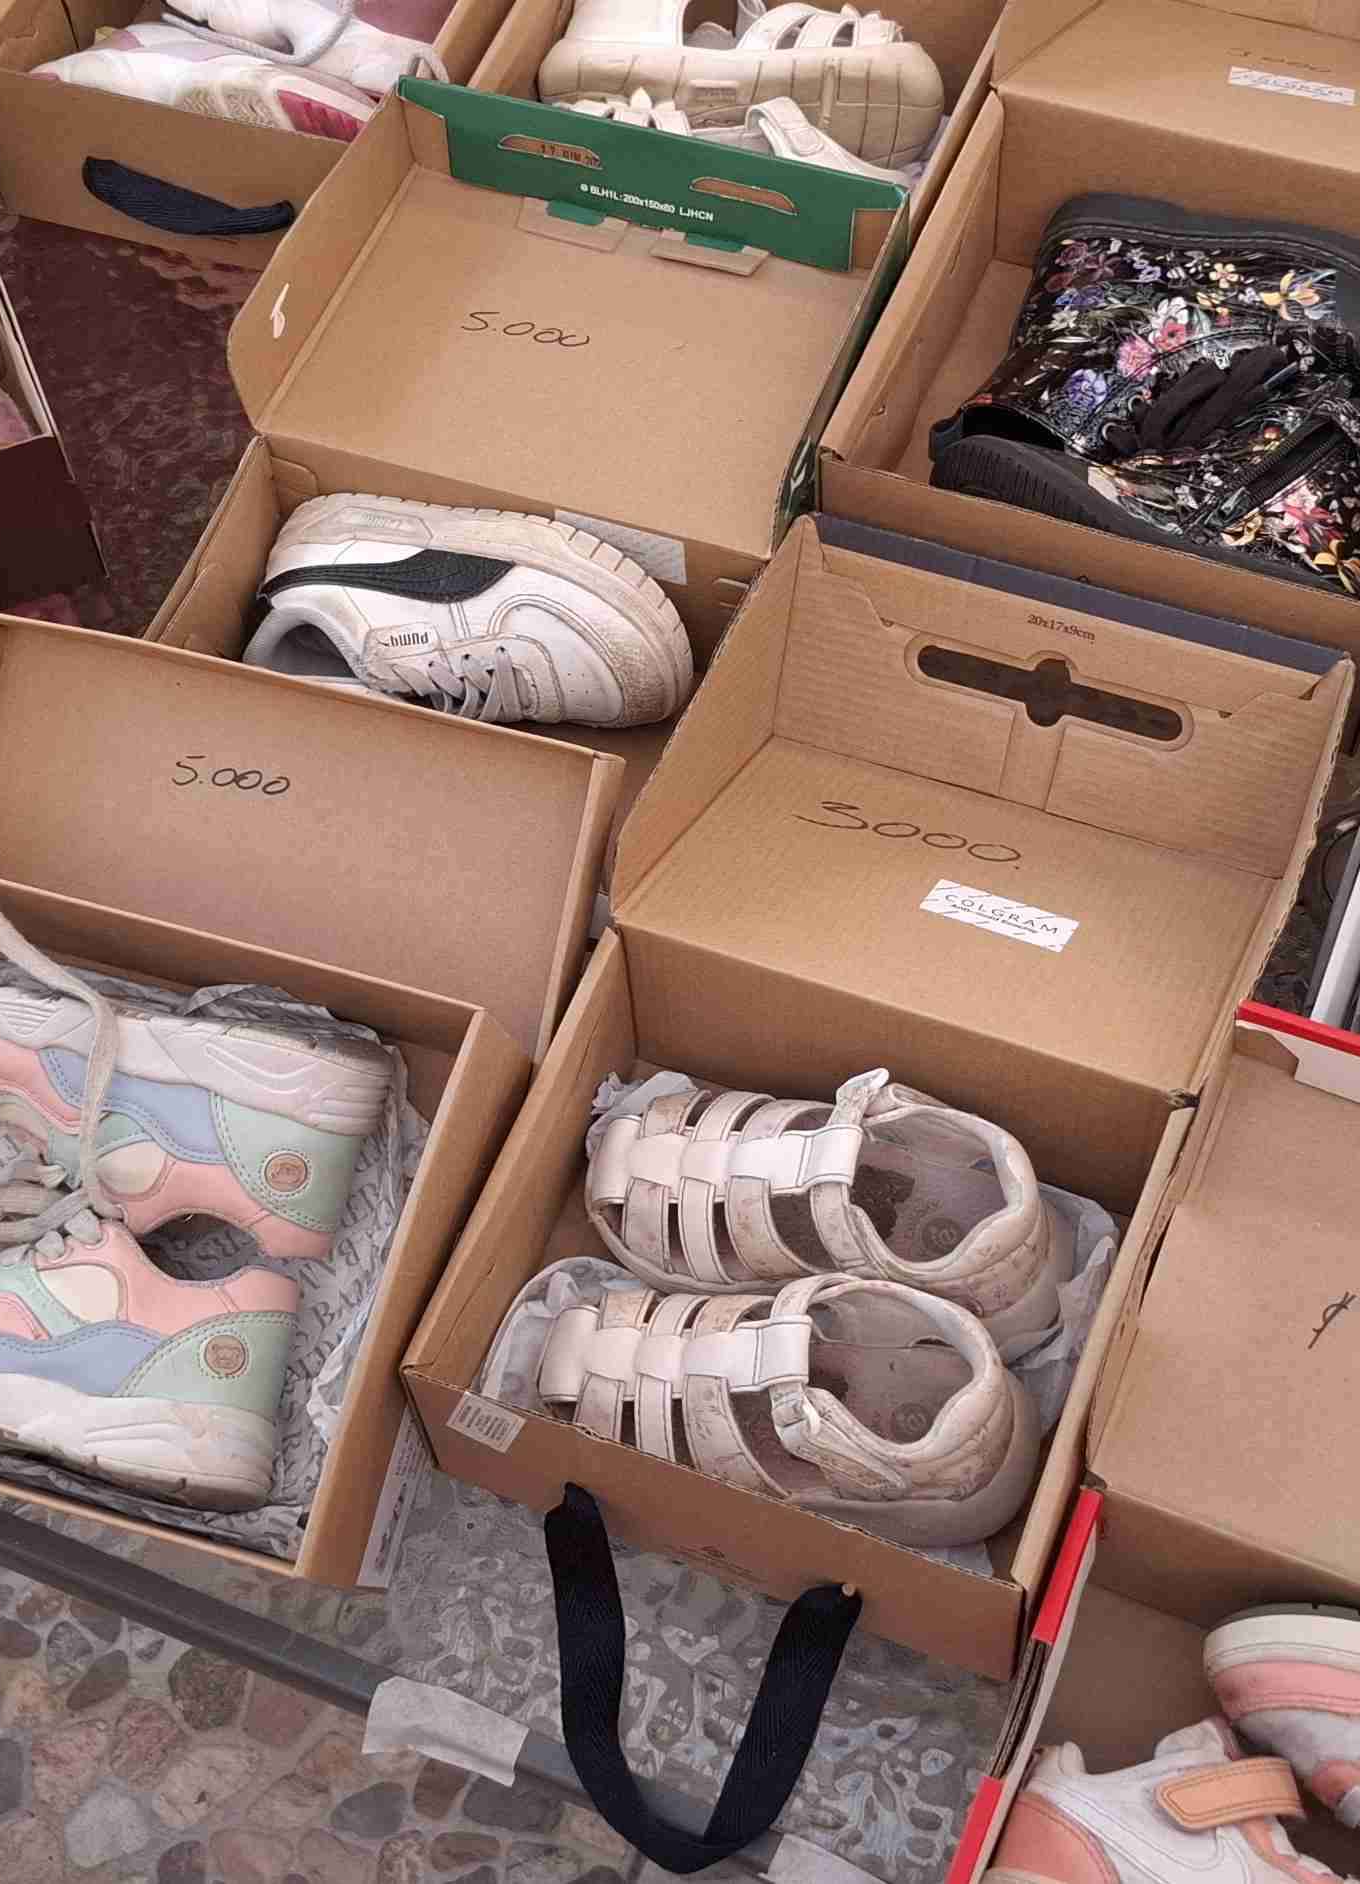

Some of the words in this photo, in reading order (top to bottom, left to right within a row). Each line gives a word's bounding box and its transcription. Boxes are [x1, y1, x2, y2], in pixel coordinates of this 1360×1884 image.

[460, 310, 591, 348] 5.000
[171, 755, 291, 795] 5.000
[944, 893, 1059, 936] COLGRAM
[1307, 1291, 1357, 1350] $
